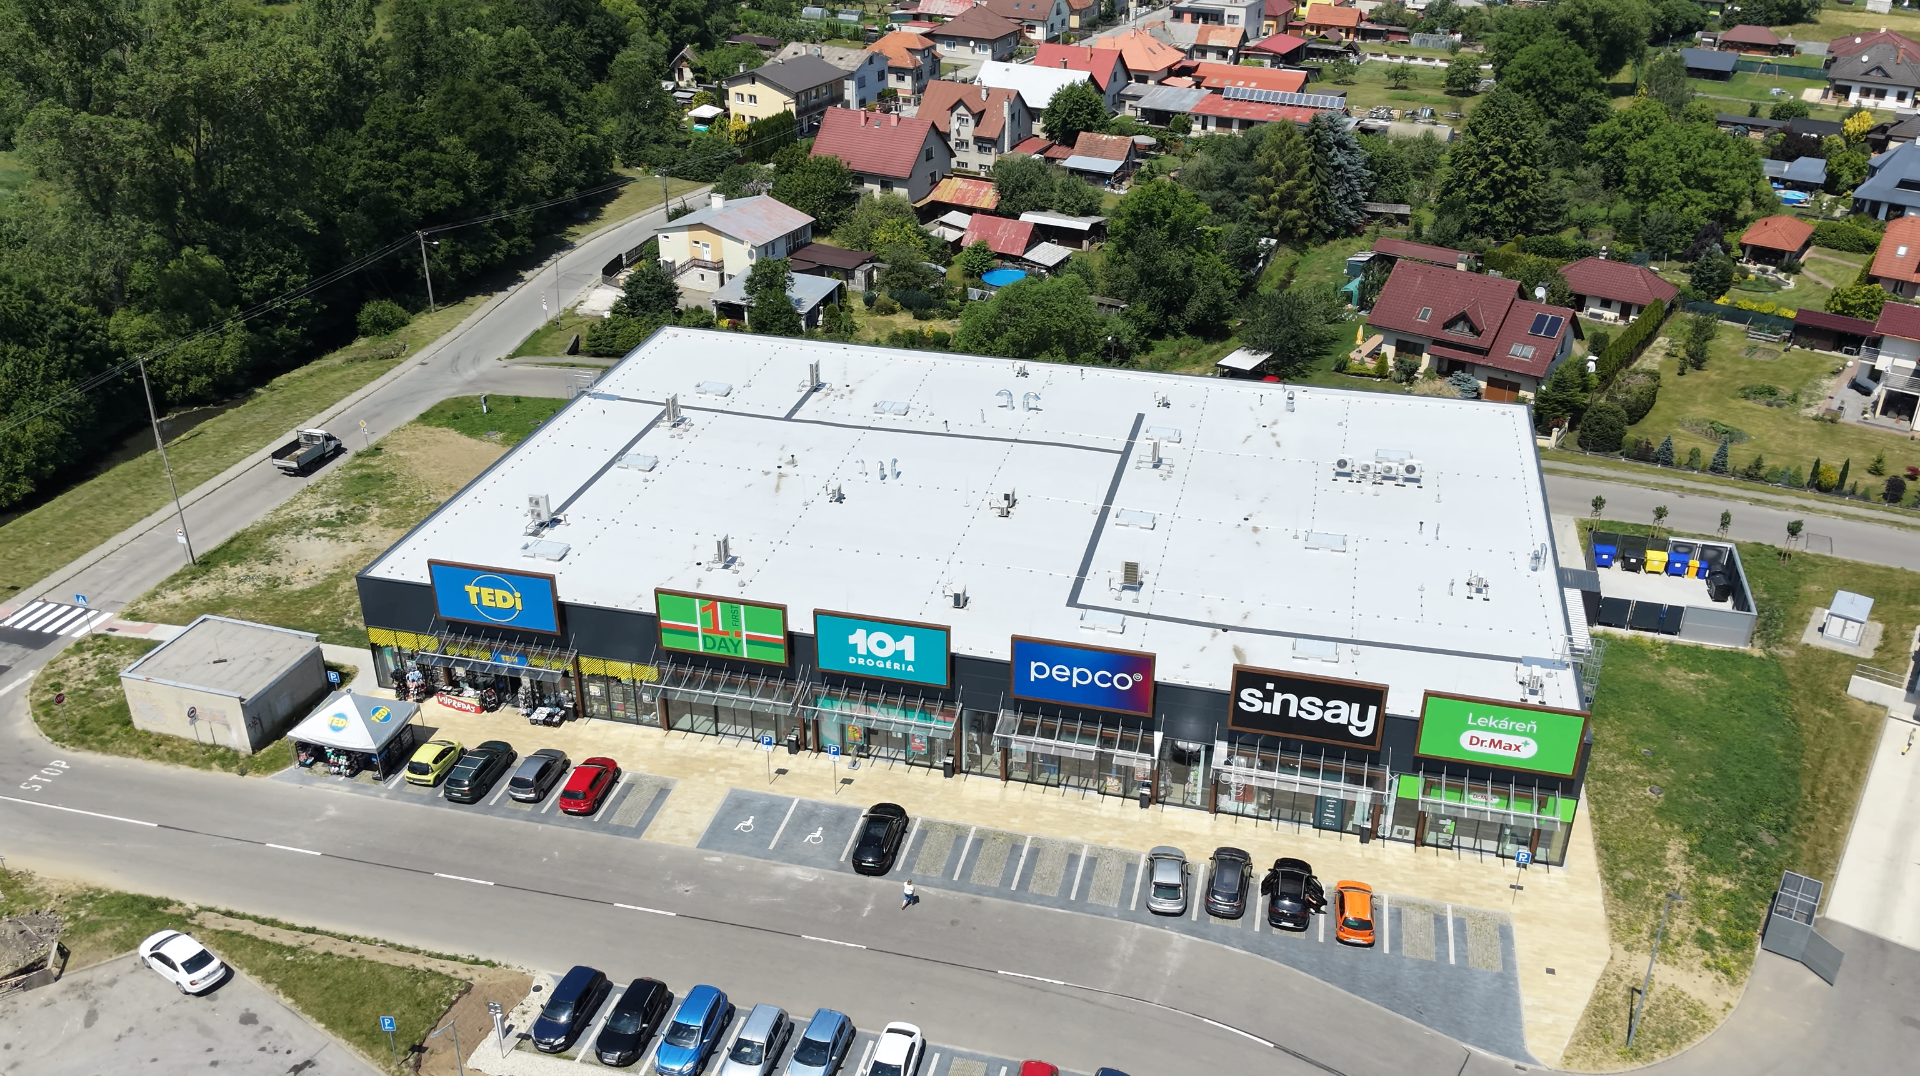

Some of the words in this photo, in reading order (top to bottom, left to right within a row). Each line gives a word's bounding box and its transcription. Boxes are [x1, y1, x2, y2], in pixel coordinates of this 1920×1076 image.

[464, 585, 523, 611] TEDi
[730, 604, 740, 627] FIRST
[702, 634, 742, 654] DAY
[848, 628, 915, 662] 101
[848, 656, 915, 673] DROGÉRIA
[1030, 660, 1133, 691] pepco
[1238, 682, 1378, 738] sinsay
[1467, 712, 1538, 734] Lekáreň
[19, 759, 70, 792] STOP
